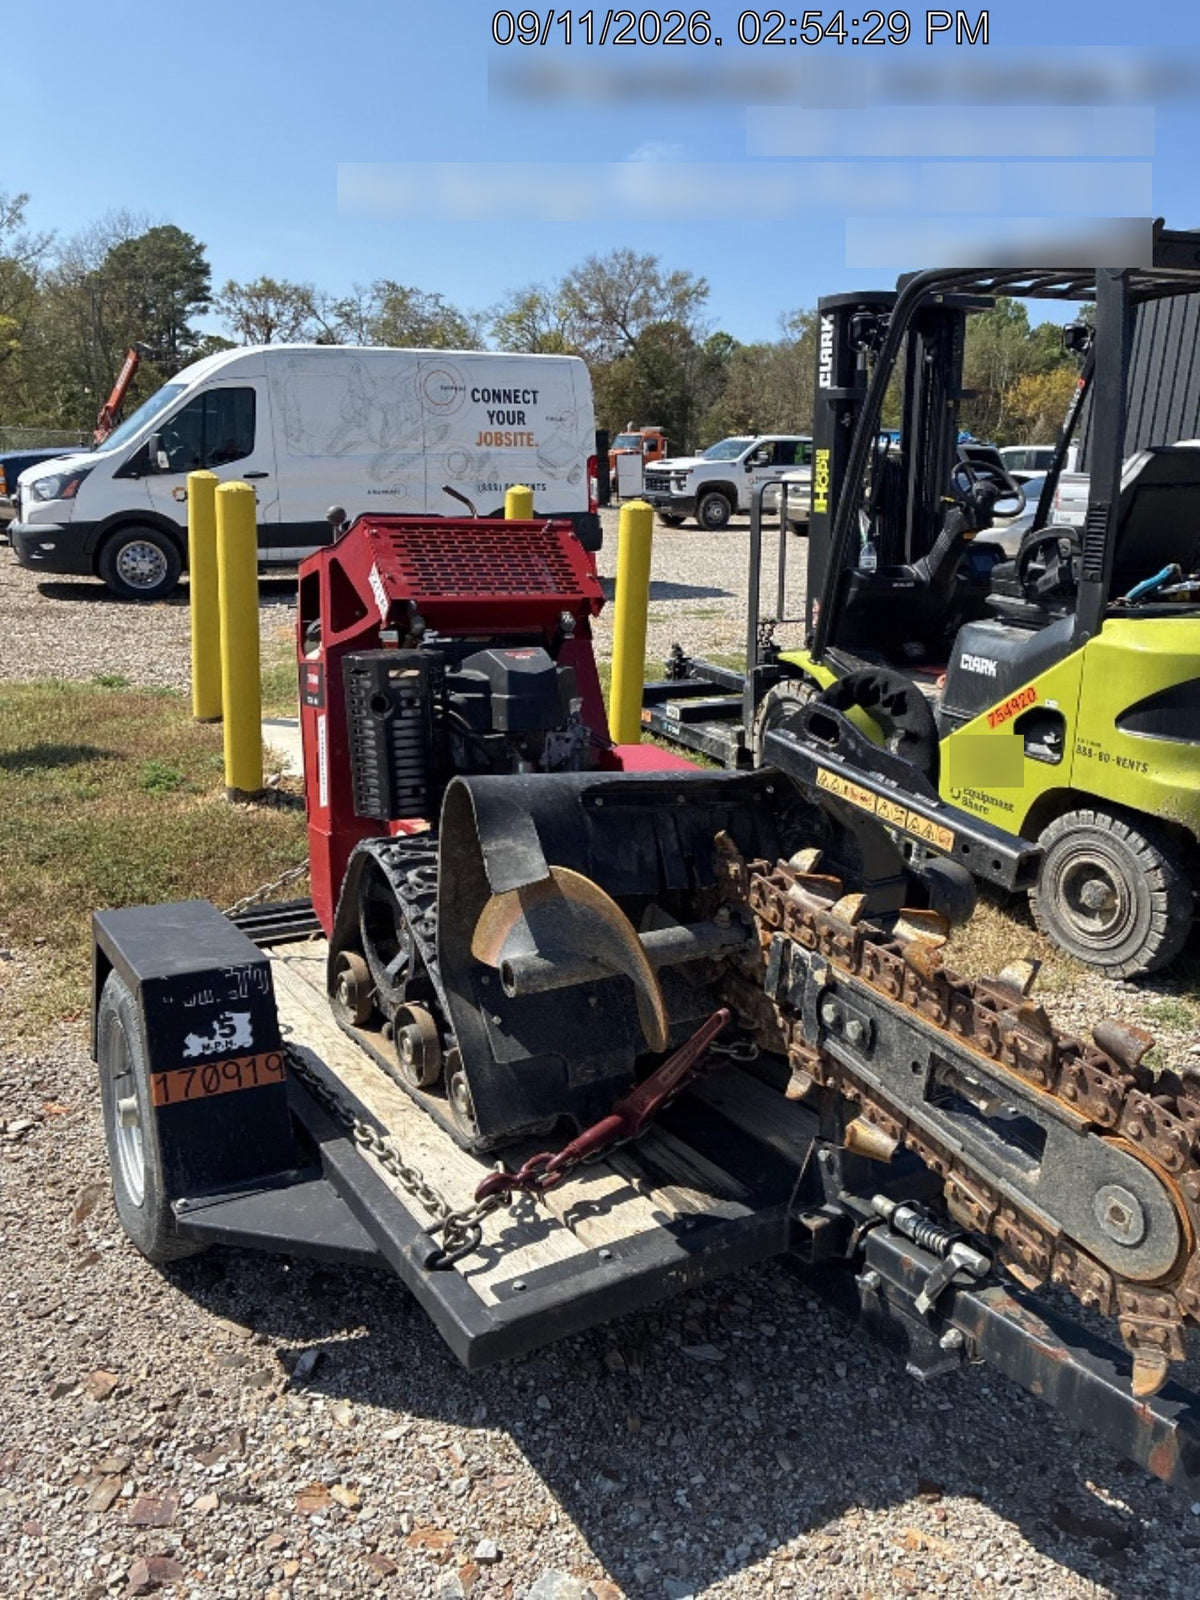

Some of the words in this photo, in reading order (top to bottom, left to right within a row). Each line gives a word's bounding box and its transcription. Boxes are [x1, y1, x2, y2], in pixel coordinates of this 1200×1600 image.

[818, 313, 835, 389] CLARK
[471, 387, 539, 405] CONNECT
[487, 410, 526, 425] YOUR
[475, 431, 540, 447] JOBSITE.
[960, 653, 998, 678] CLARK
[987, 687, 1036, 729] 754920
[155, 1053, 285, 1103] 170919
